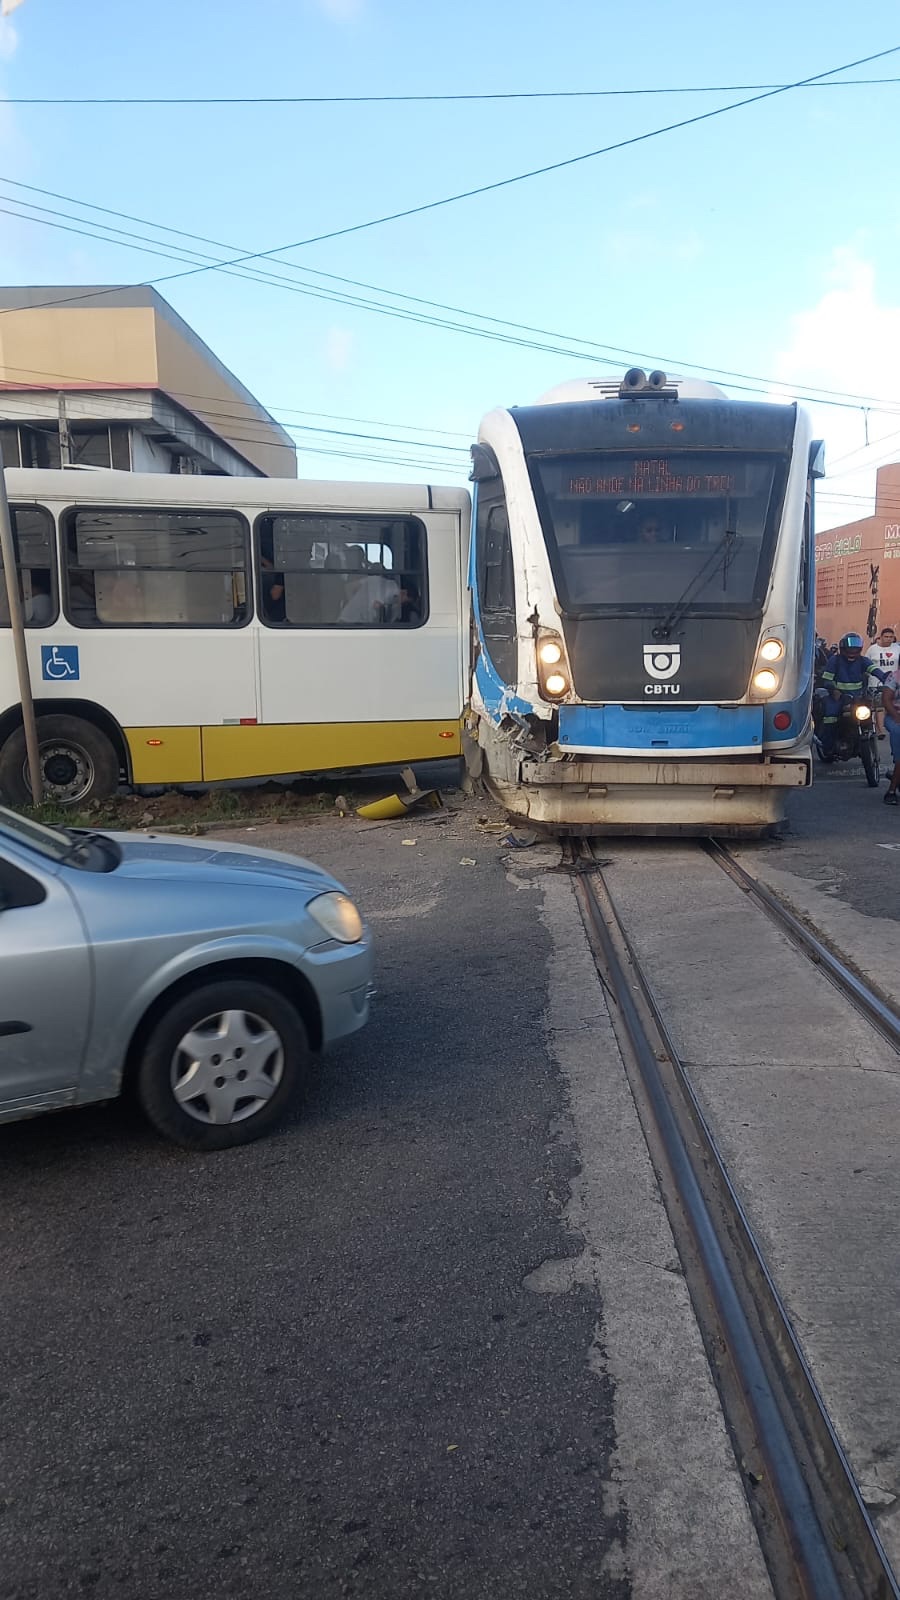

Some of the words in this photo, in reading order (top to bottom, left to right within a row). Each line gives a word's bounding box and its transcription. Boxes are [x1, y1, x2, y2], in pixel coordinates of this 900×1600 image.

[634, 460, 670, 476] NATAL
[815, 542, 833, 562] OTO
[644, 684, 680, 694] CBTU
